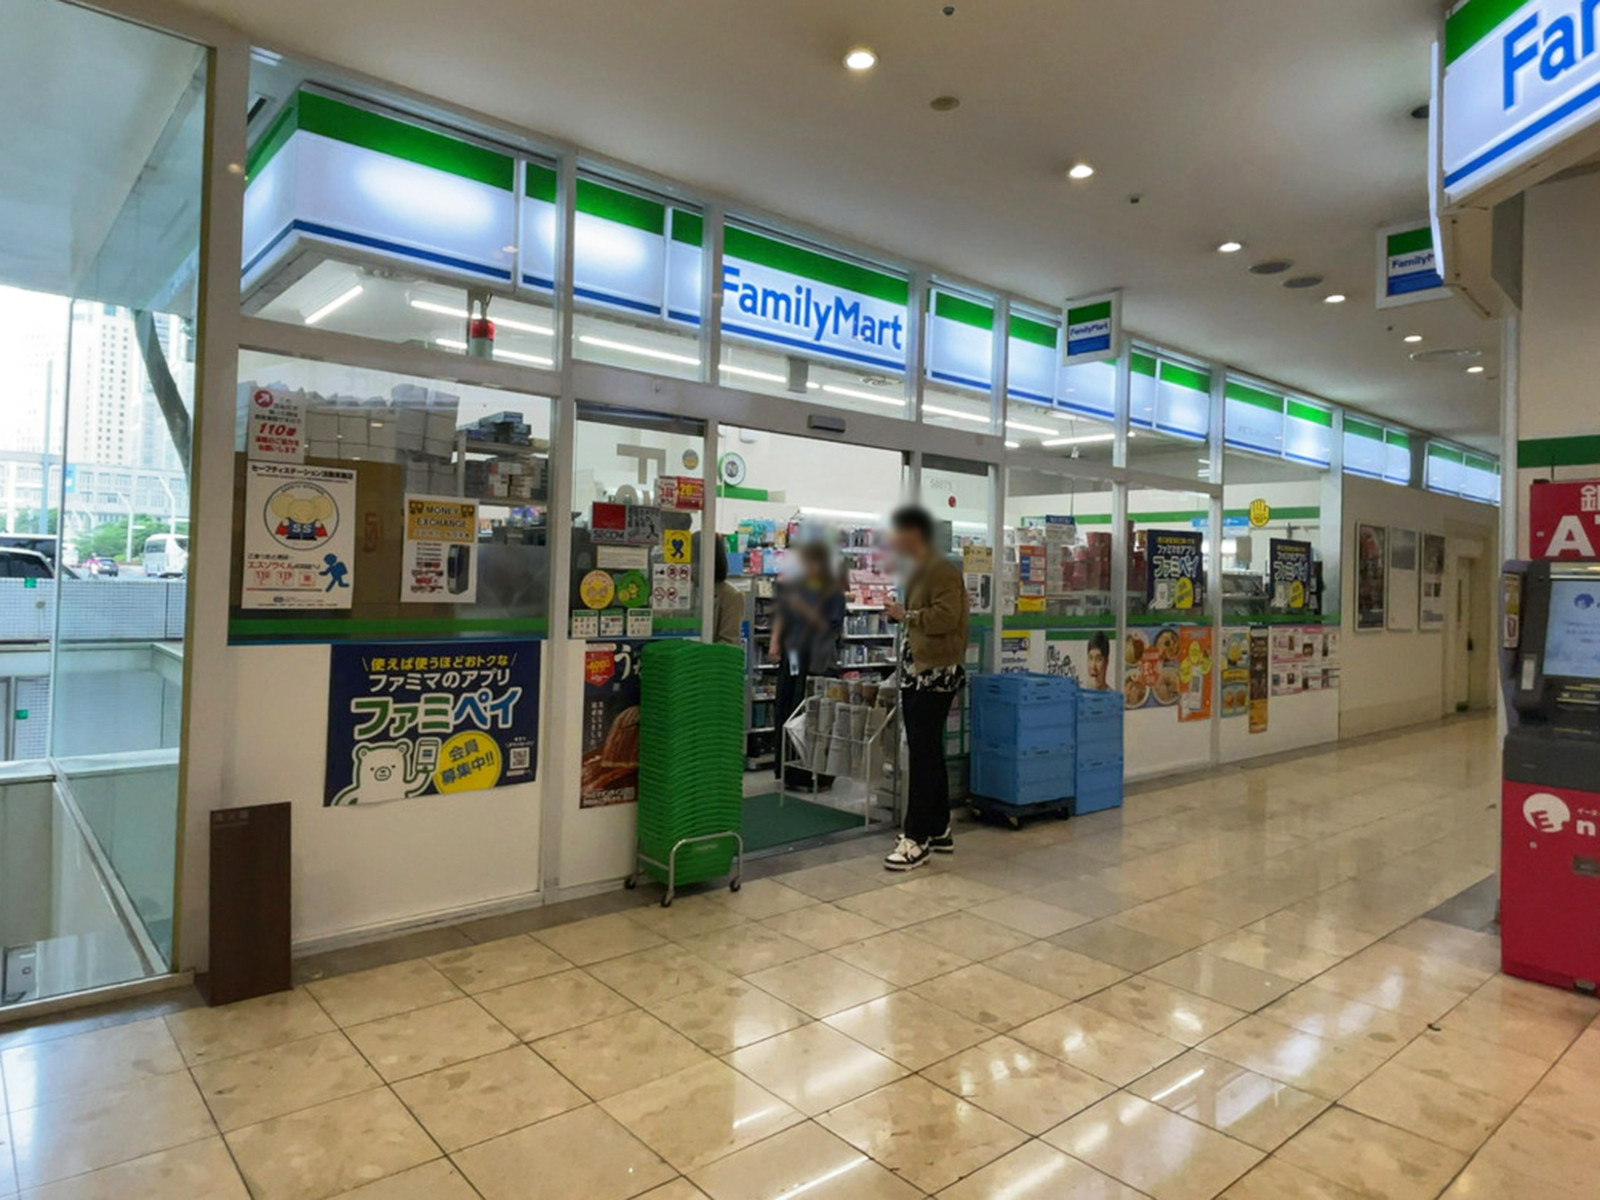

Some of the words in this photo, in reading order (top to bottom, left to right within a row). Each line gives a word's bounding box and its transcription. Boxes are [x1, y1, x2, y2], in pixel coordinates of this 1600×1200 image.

[722, 265, 902, 350] FamilyMart
[1070, 321, 1108, 336] FamilyMart
[426, 506, 459, 515] MONEY
[416, 517, 466, 528] EXCHANGE
[1544, 515, 1600, 557] A
[371, 655, 509, 672] 使えば使うほどおトクな
[369, 668, 510, 692] ファミマのアプリ
[351, 687, 522, 740] ファミペイ
[449, 739, 479, 762] 会員
